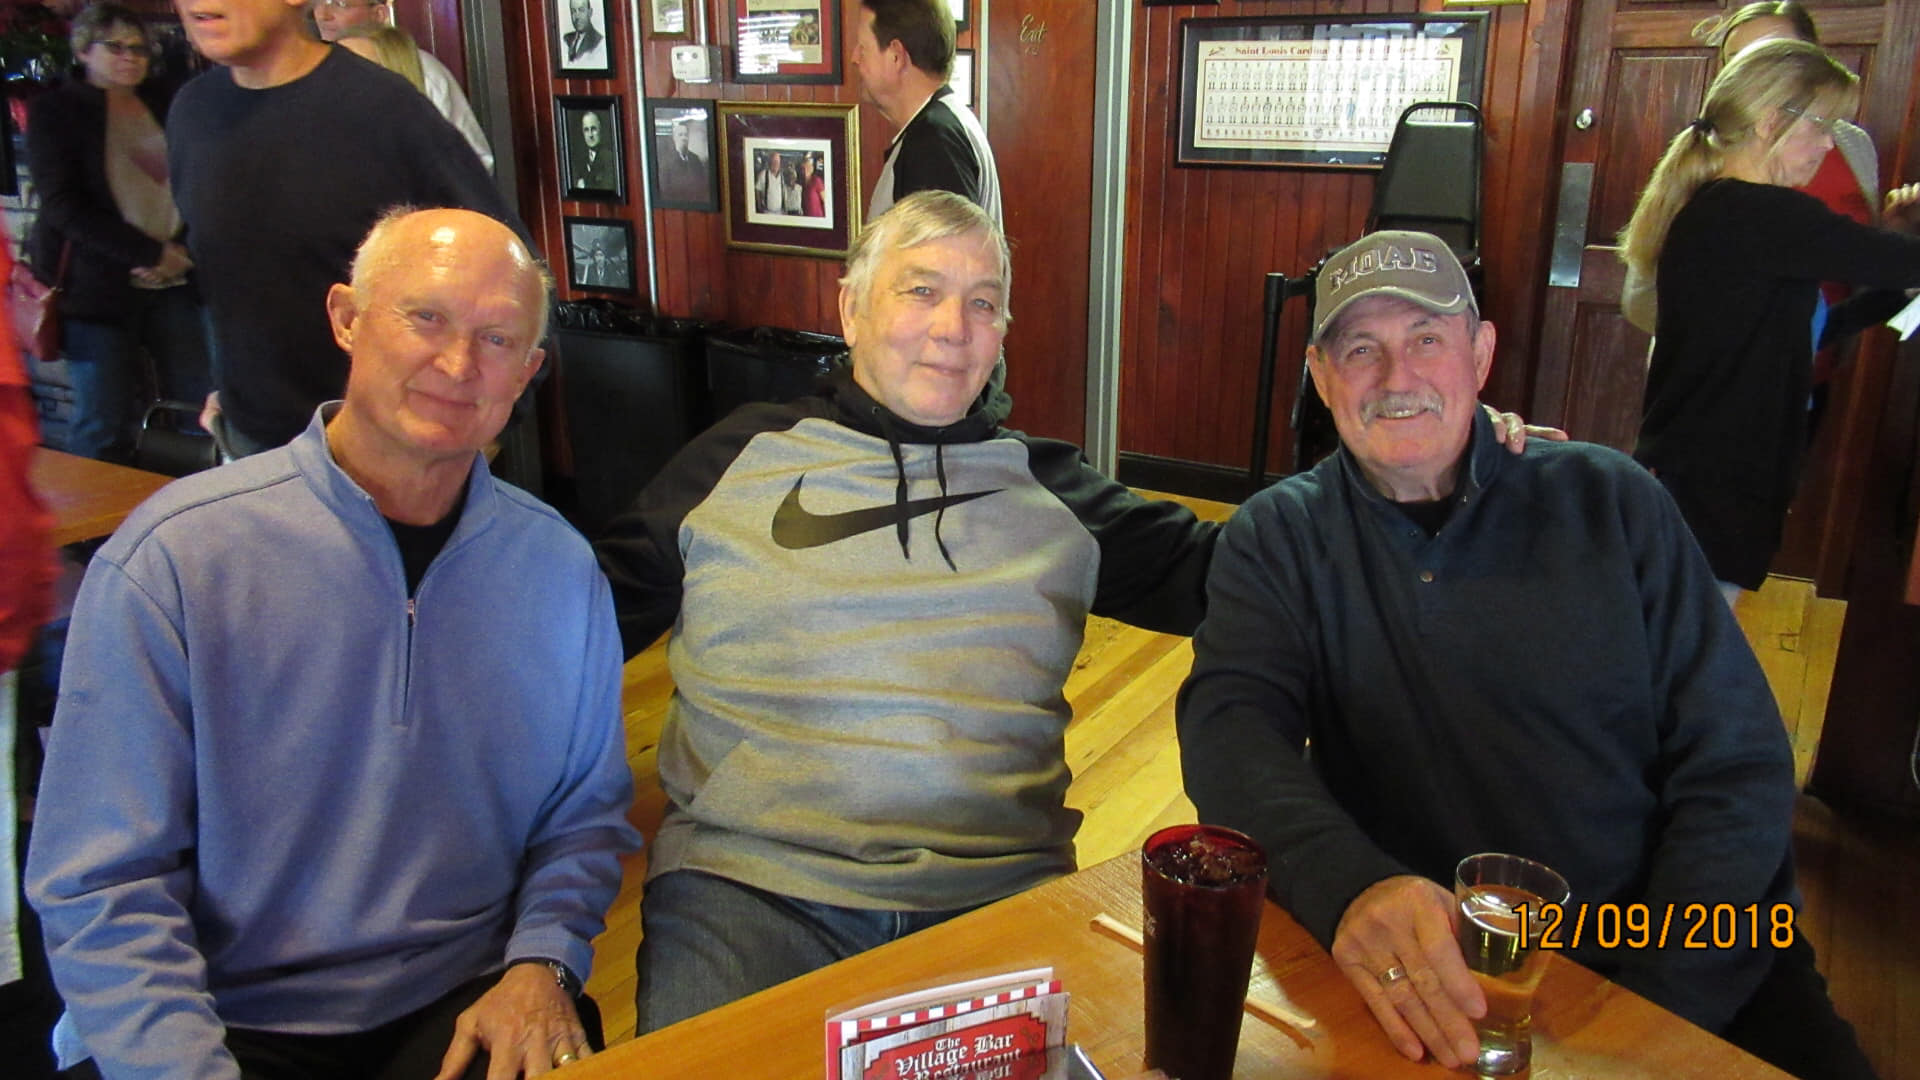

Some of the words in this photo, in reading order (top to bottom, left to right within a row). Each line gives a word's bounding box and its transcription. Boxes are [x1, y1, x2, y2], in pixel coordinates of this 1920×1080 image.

[1235, 46, 1259, 56] Saint
[1262, 46, 1288, 56] Louis
[1290, 46, 1337, 56] Cardina
[935, 1037, 961, 1052] The
[895, 1043, 968, 1077] Village
[974, 1032, 1015, 1058] Bar
